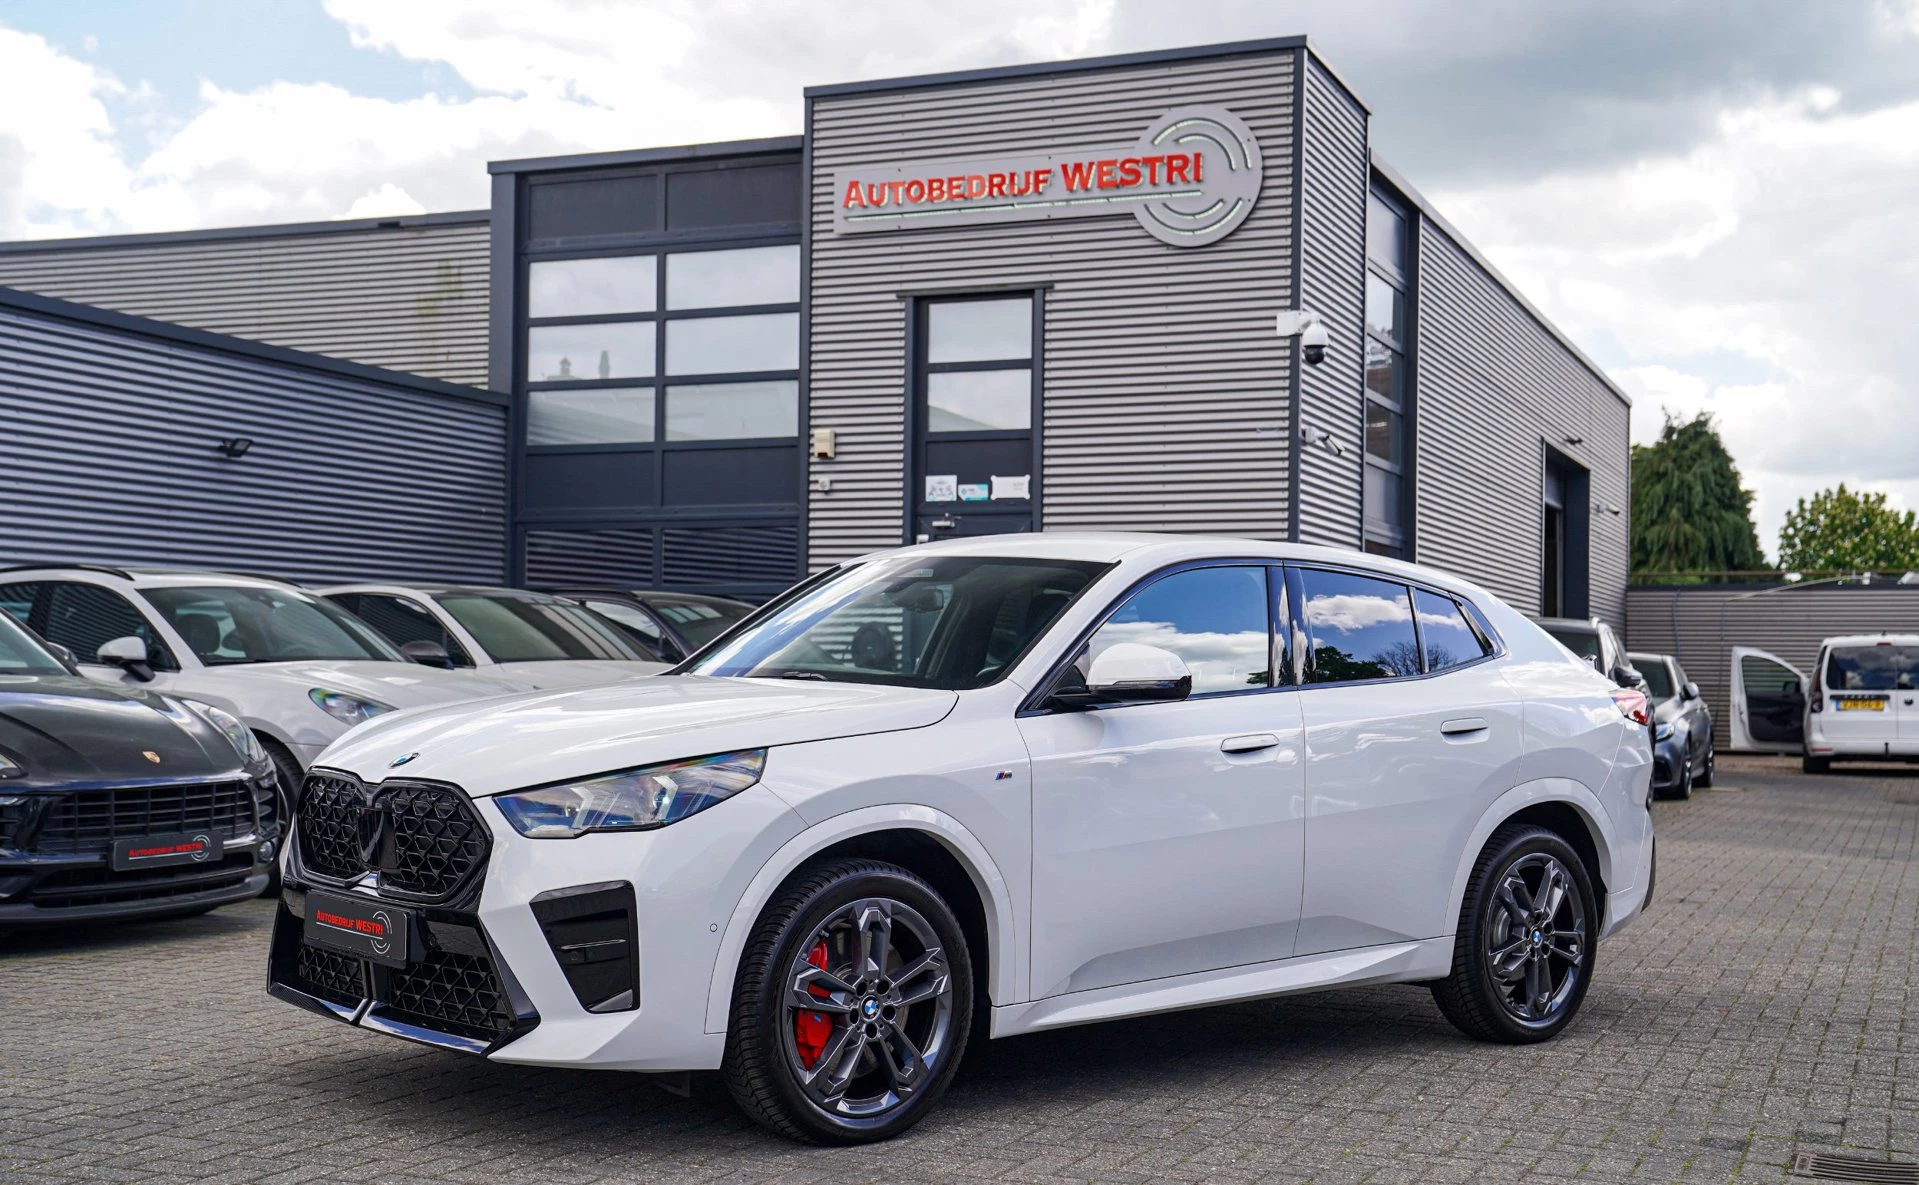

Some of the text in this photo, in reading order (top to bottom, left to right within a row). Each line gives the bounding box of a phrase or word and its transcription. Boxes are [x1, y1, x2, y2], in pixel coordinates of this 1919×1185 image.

[843, 152, 1202, 209] AUTOBEDRIJF WESTRI
[316, 909, 384, 936] AUTOBEDRIJF WESTRI
